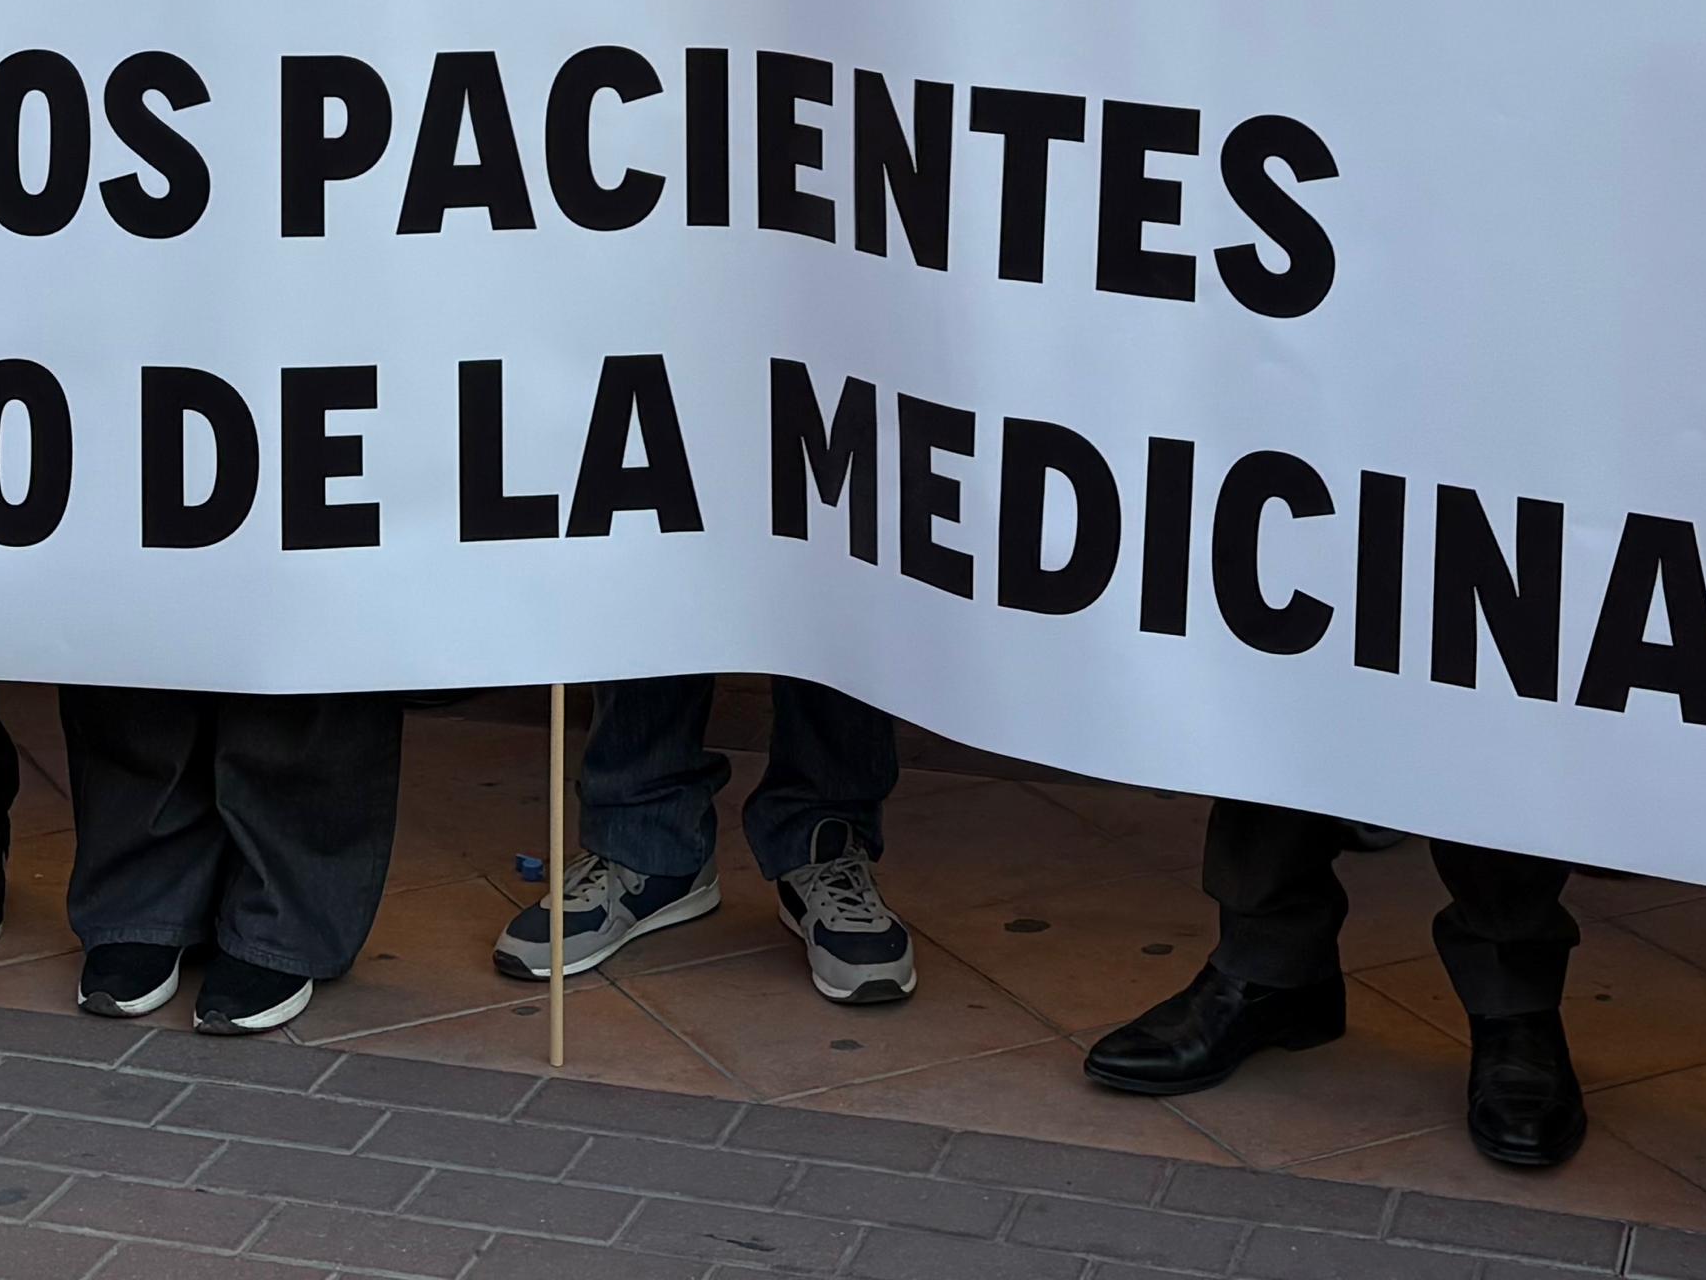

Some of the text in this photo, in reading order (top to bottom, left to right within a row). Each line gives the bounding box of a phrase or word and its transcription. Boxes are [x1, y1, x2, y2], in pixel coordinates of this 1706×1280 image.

[278, 45, 1340, 320] PACIENTES
[141, 364, 381, 552] DE
[458, 353, 705, 544] LA
